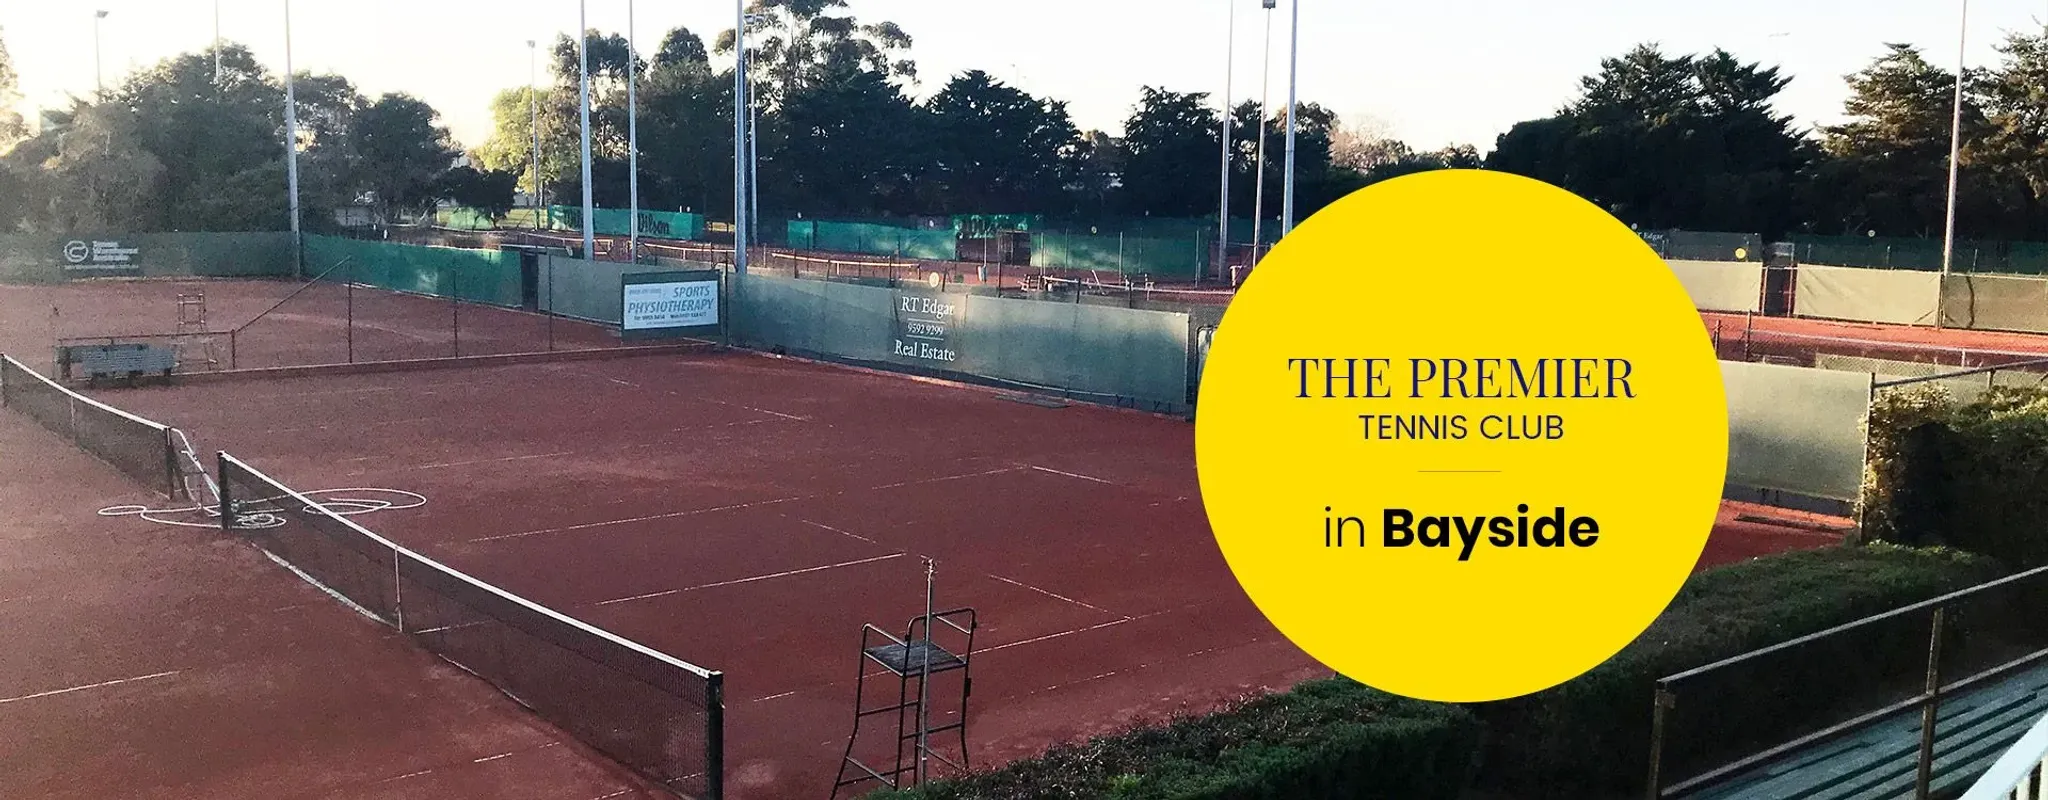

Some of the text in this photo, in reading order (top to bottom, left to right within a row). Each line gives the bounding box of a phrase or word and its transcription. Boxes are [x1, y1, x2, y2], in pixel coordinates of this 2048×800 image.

[673, 285, 710, 298] SPORTS
[627, 298, 715, 314] PHYSIOTHERAPY
[901, 296, 955, 319] RT Edgar
[907, 322, 944, 336] 9592 9299
[894, 339, 956, 361] Real Estate
